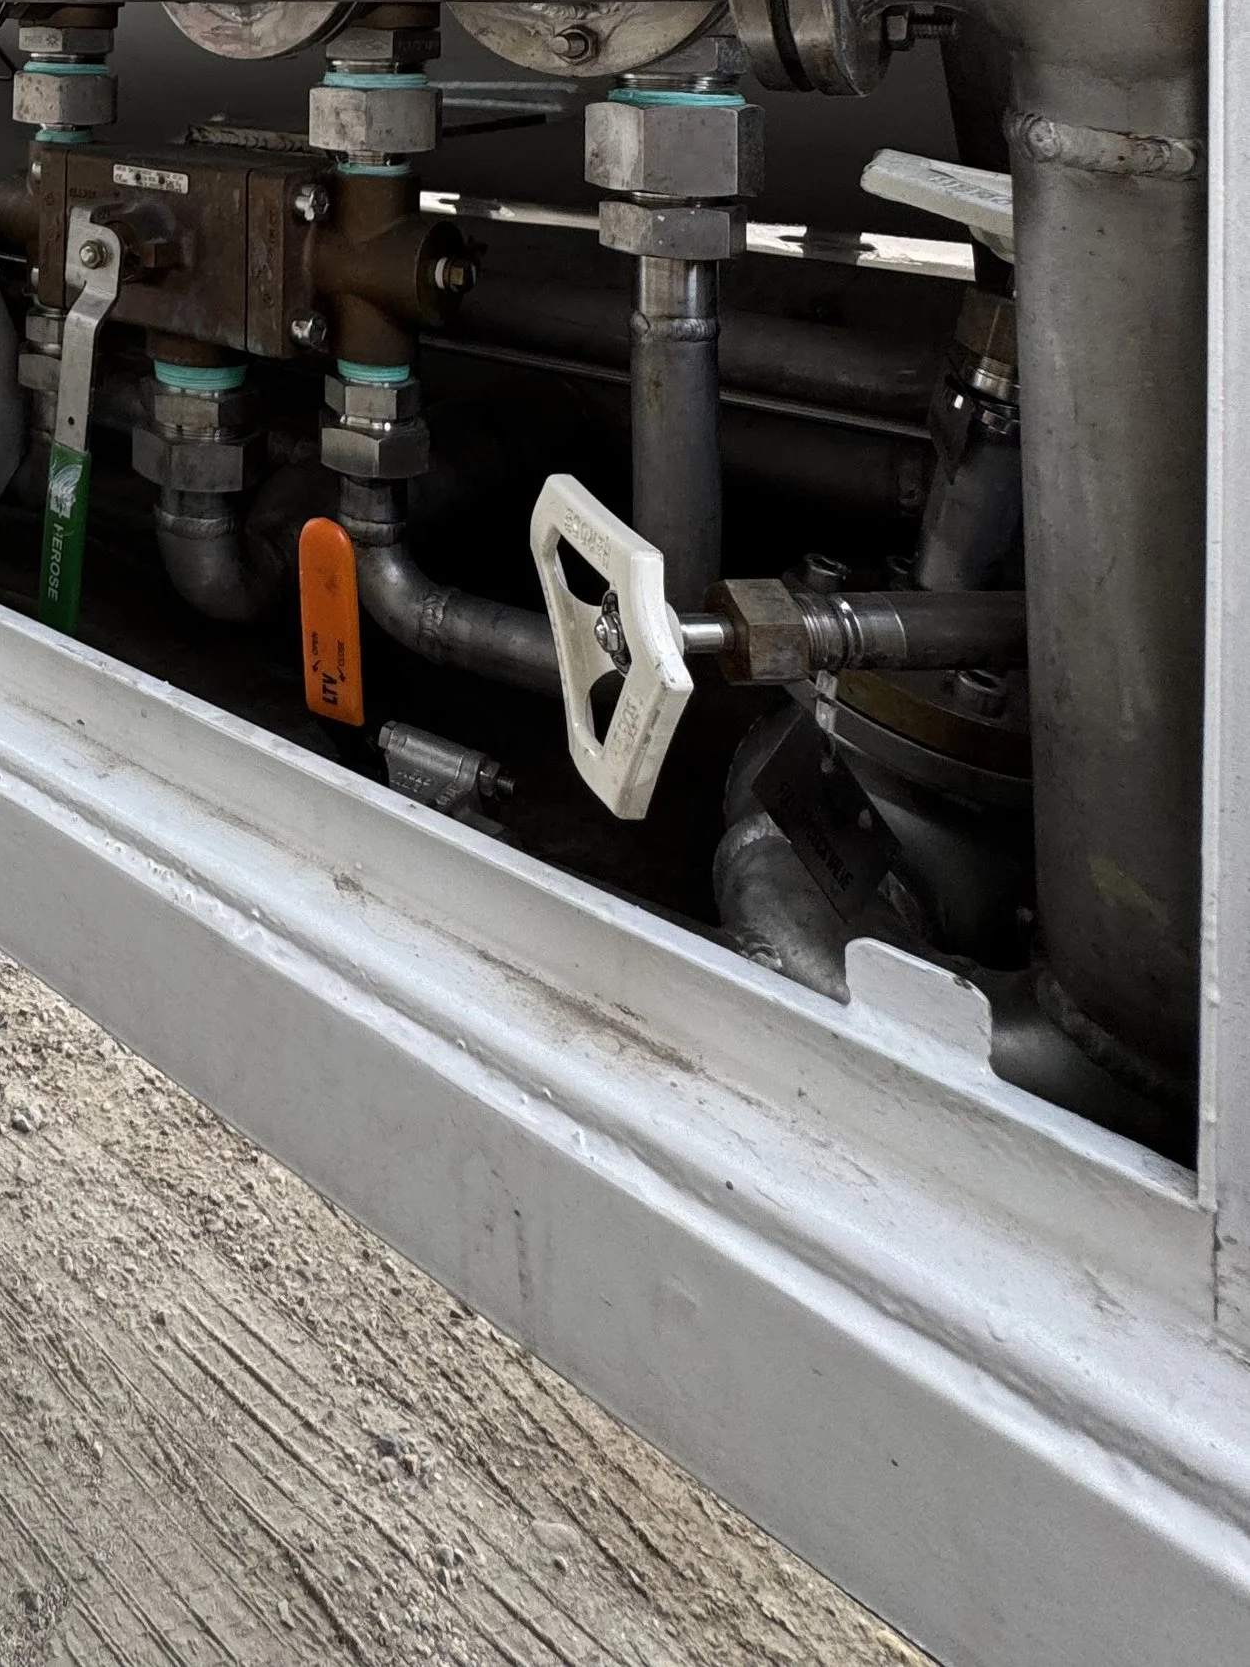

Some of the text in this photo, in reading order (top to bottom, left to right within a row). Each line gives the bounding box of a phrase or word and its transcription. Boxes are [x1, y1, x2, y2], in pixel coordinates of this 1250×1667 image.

[47, 522, 64, 603] HEROSE
[311, 631, 319, 656] OPEN
[321, 672, 338, 706] LTV
